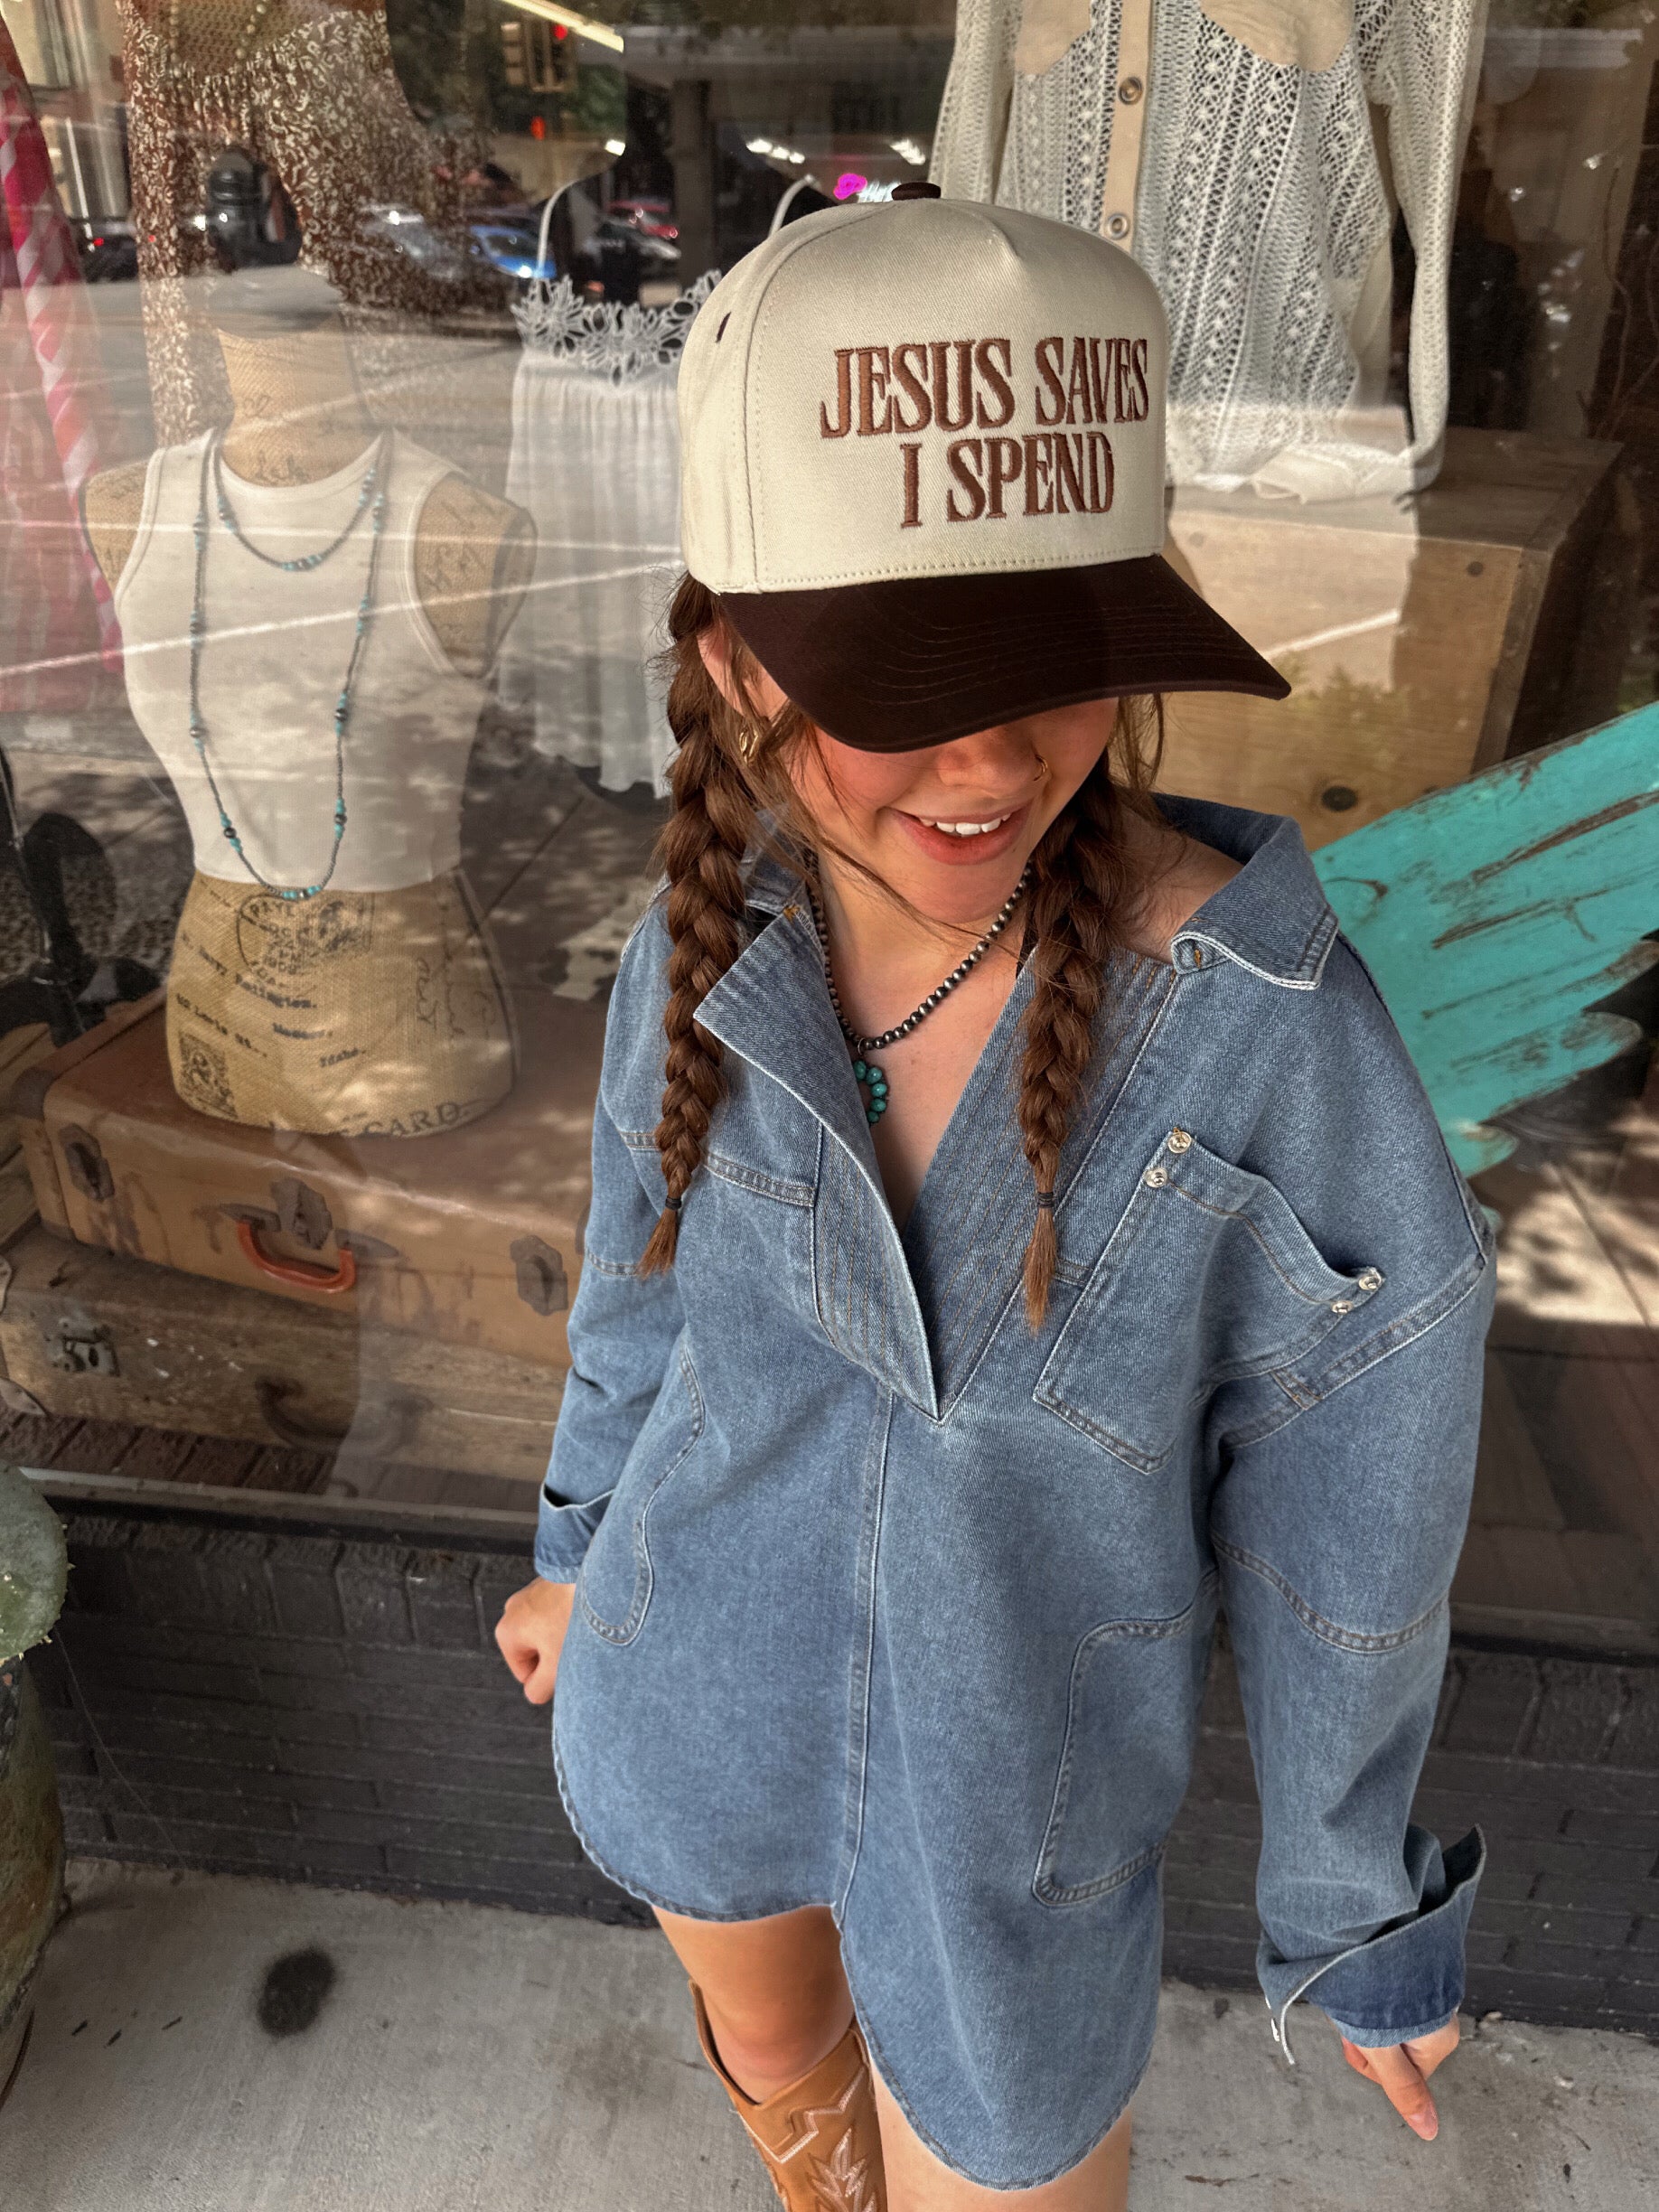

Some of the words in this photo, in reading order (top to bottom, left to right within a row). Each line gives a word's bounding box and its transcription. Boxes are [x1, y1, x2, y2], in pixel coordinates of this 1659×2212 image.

[820, 338, 1016, 439] JESUS
[1035, 336, 1149, 426] SAVES
[899, 442, 923, 529] I
[946, 431, 1115, 522] SPEND
